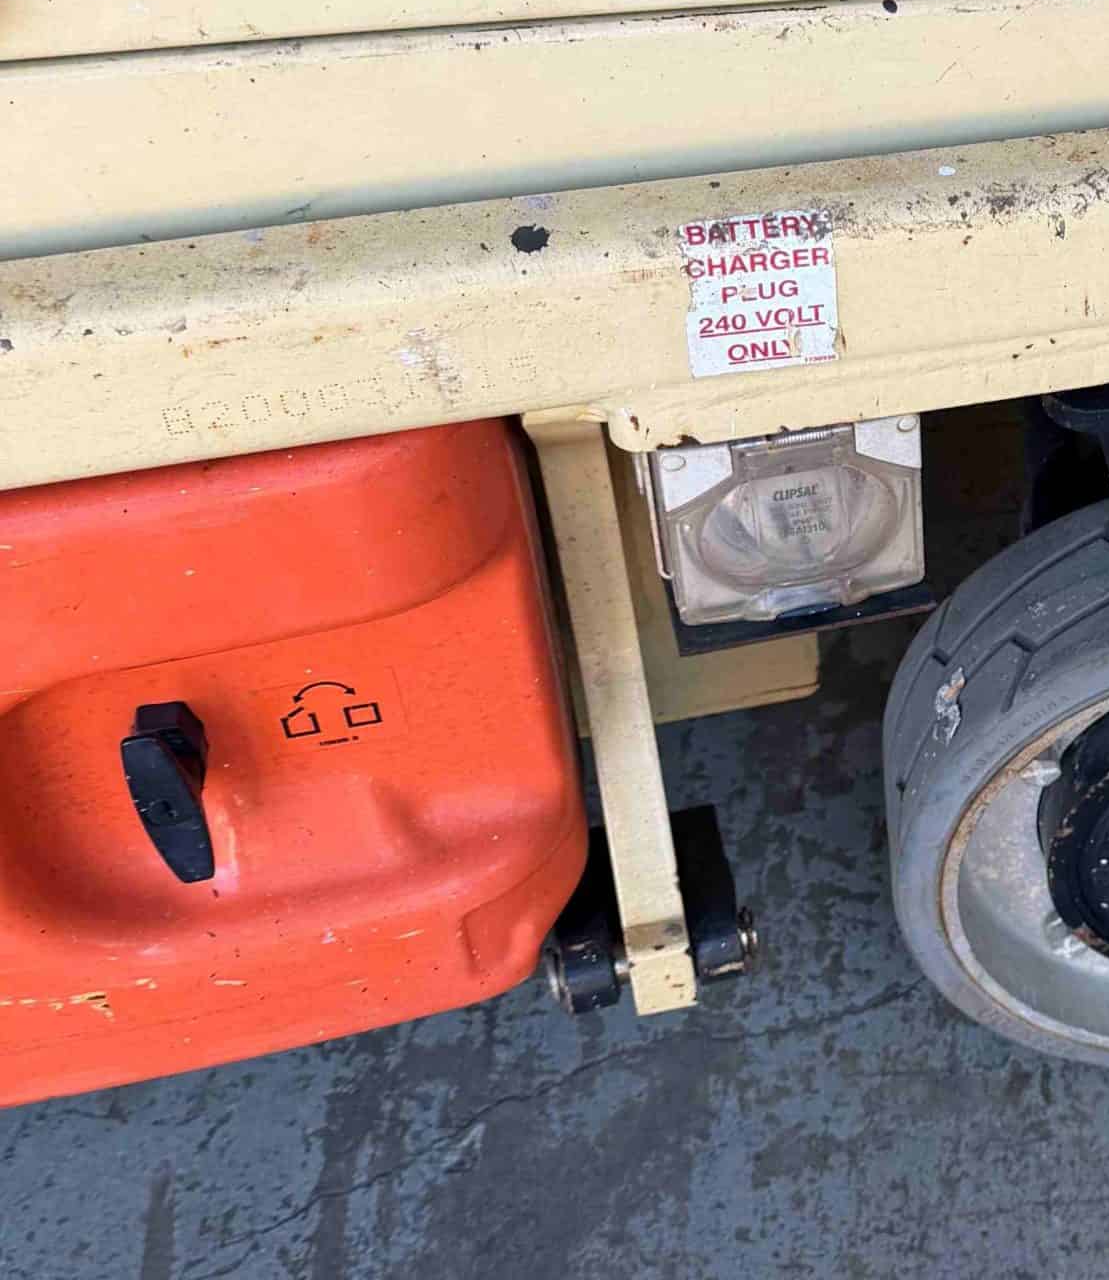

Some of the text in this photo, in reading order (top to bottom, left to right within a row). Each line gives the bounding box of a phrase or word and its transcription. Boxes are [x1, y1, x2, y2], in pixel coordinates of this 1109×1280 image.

[685, 213, 819, 246] BATTERY
[686, 247, 830, 280] CHARGER
[699, 304, 825, 335] 240 VOLT
[773, 484, 818, 501] CLIPSAL
